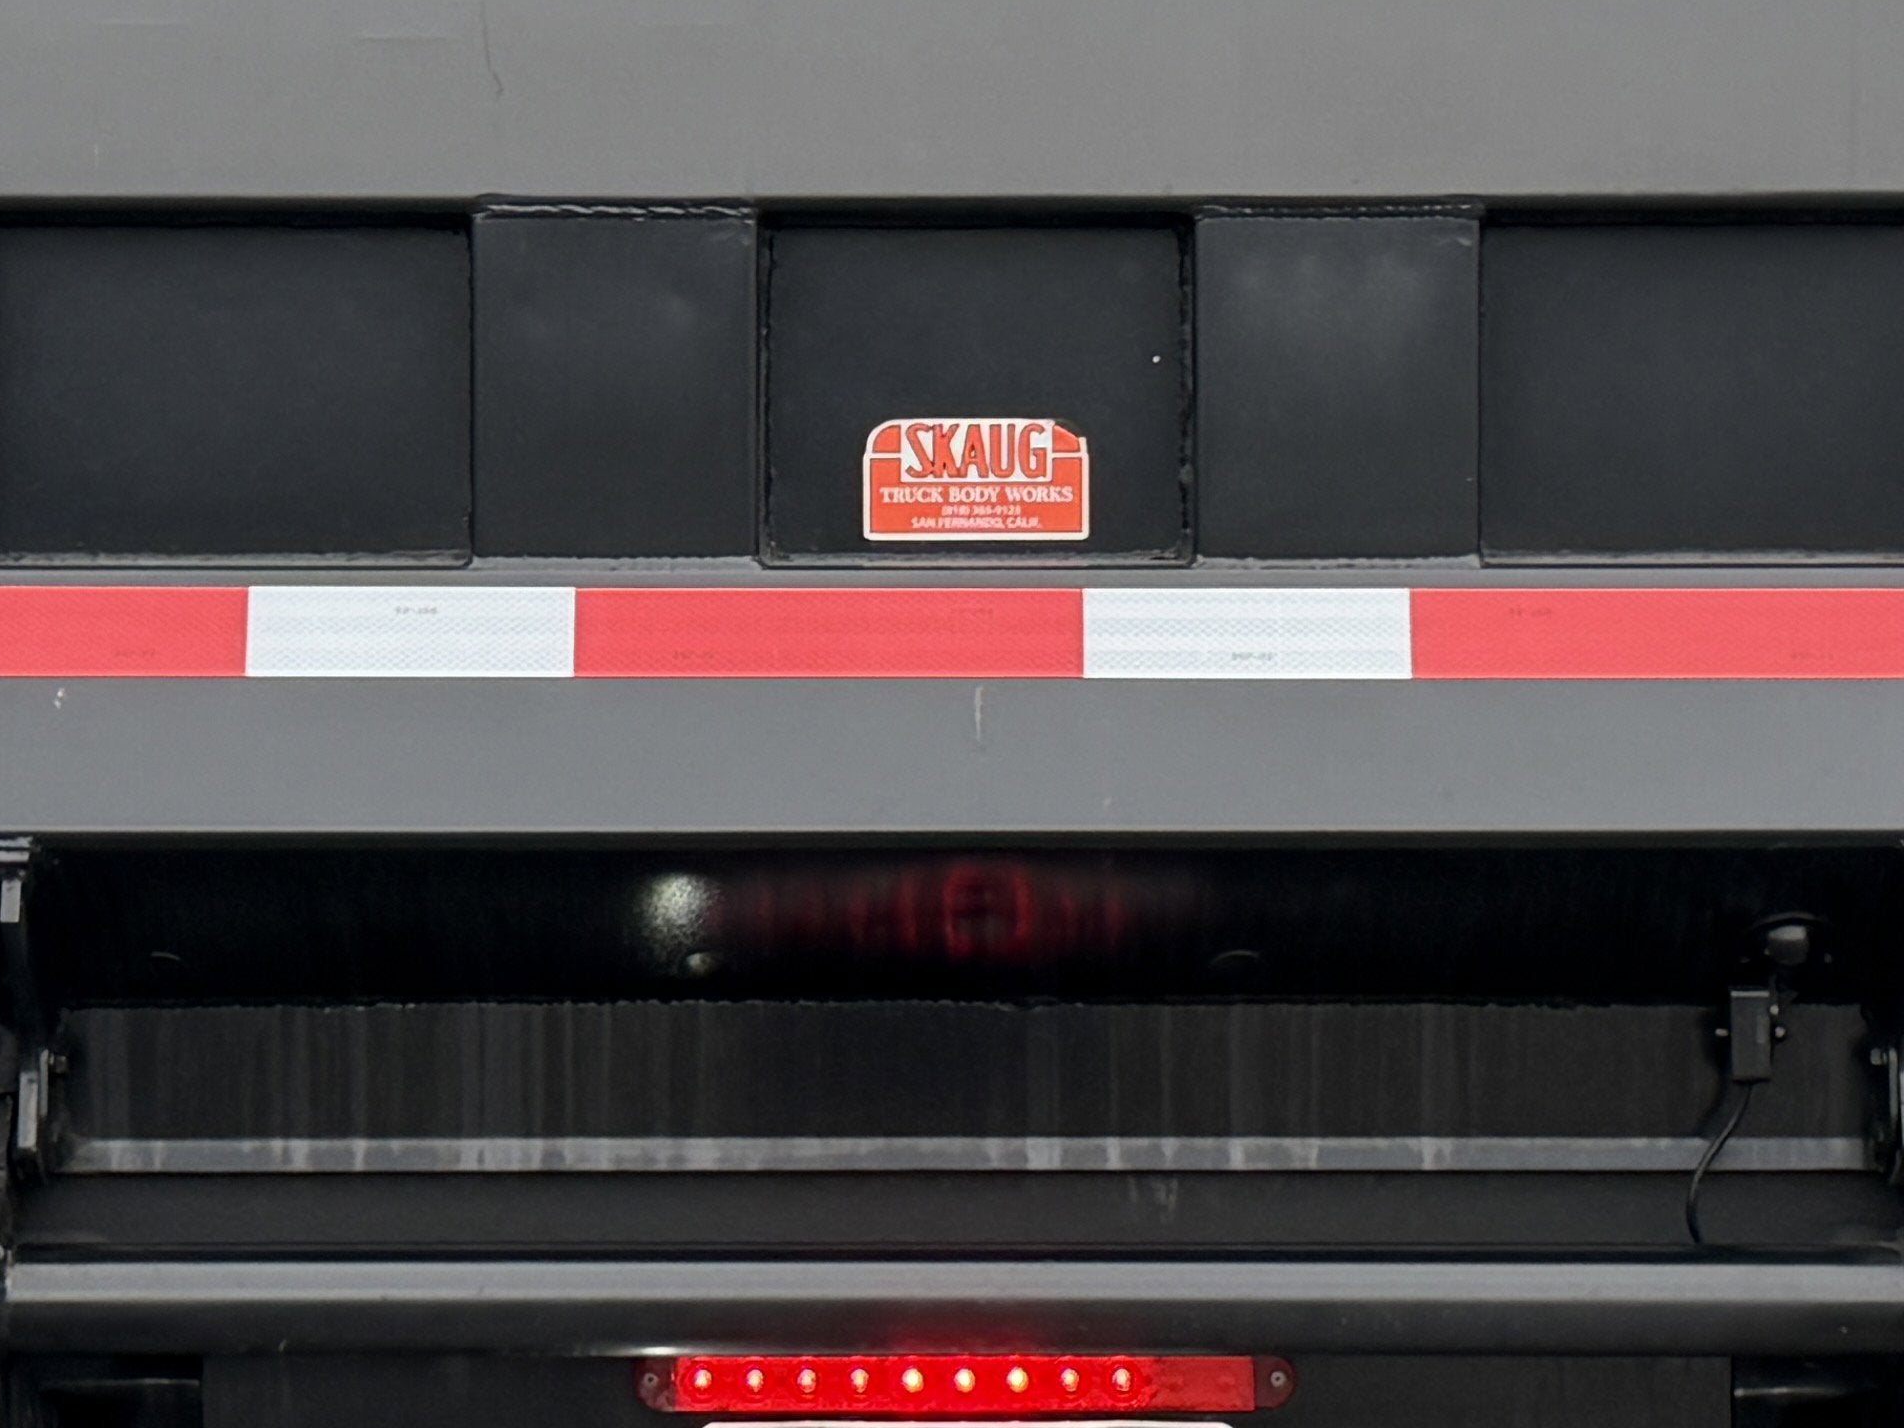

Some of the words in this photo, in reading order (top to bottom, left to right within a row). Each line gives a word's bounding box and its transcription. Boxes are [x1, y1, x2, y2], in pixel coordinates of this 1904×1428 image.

[904, 422, 1047, 478] SKAUG
[880, 486, 944, 503] TRUCK
[948, 486, 1000, 503] BODY
[1004, 485, 1074, 503] WORKS
